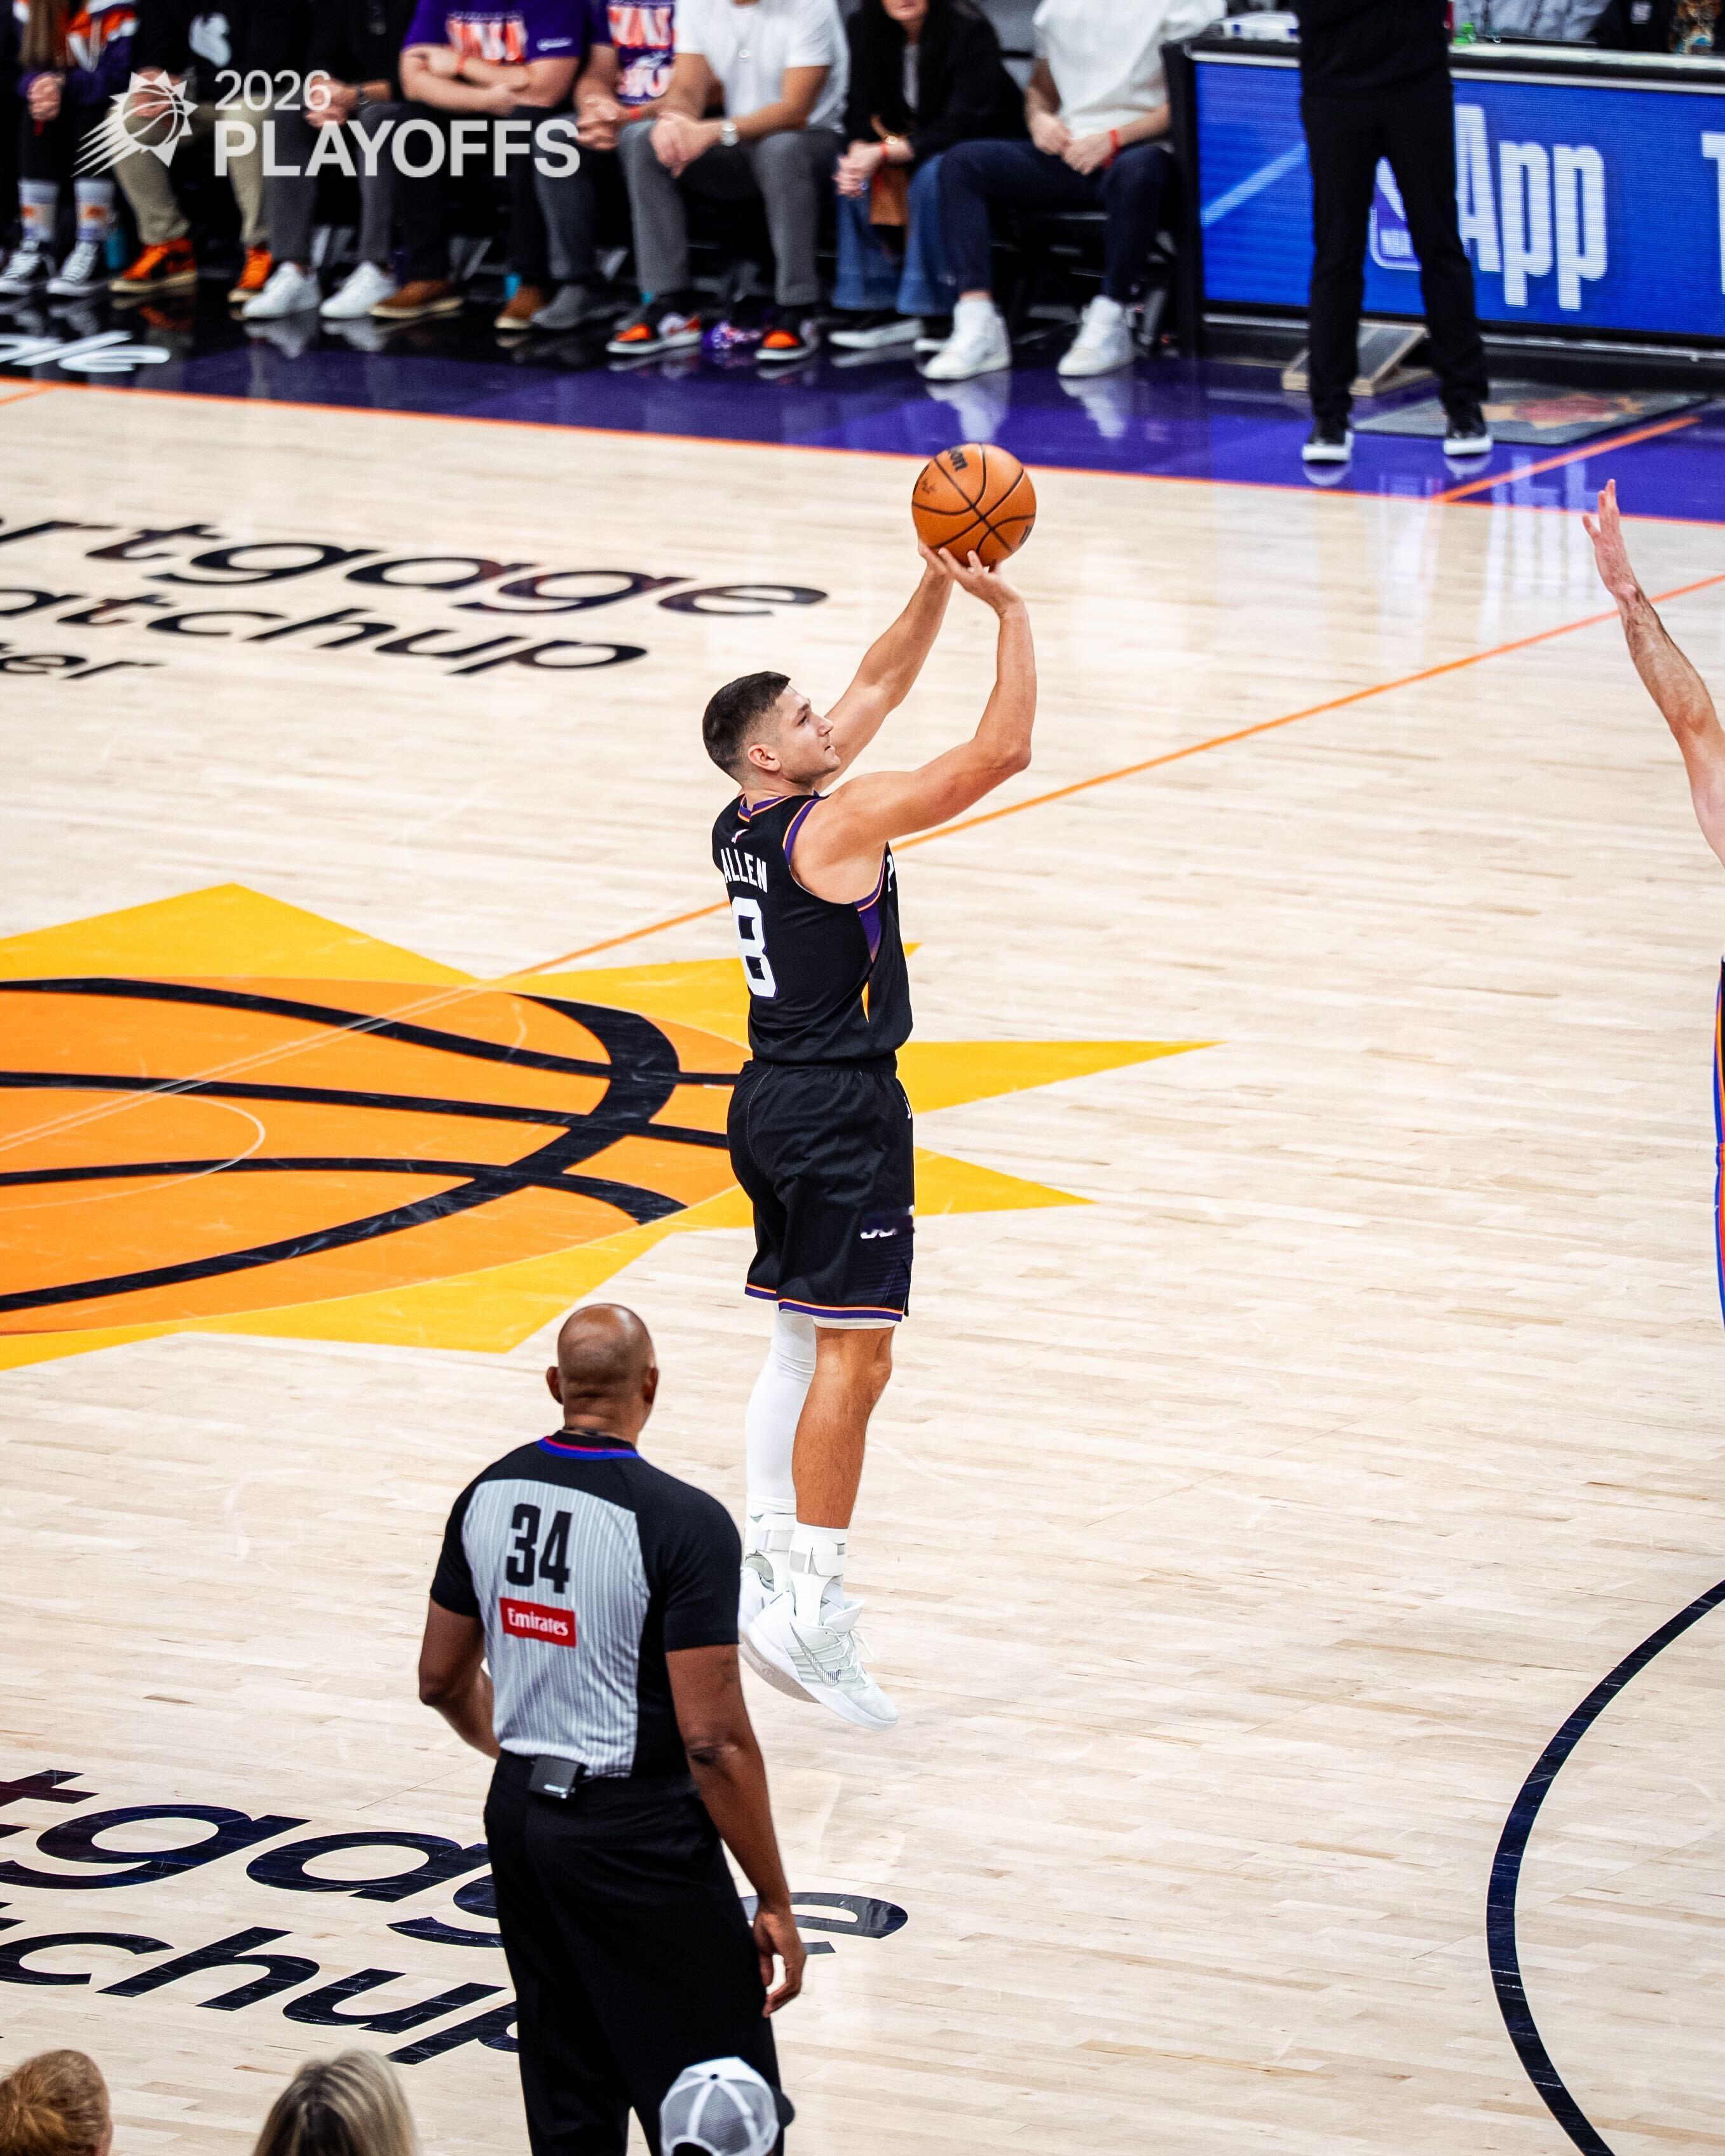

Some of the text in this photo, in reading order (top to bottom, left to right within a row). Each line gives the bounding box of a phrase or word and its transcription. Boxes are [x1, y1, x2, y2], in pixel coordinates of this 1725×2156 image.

[1455, 104, 1607, 311] App
[0, 520, 829, 615] rtgage
[0, 642, 164, 680] er
[721, 847, 768, 893] ALLEN
[731, 895, 779, 1000] 8
[506, 1503, 573, 1594] 34
[507, 1607, 569, 1637] Emirates
